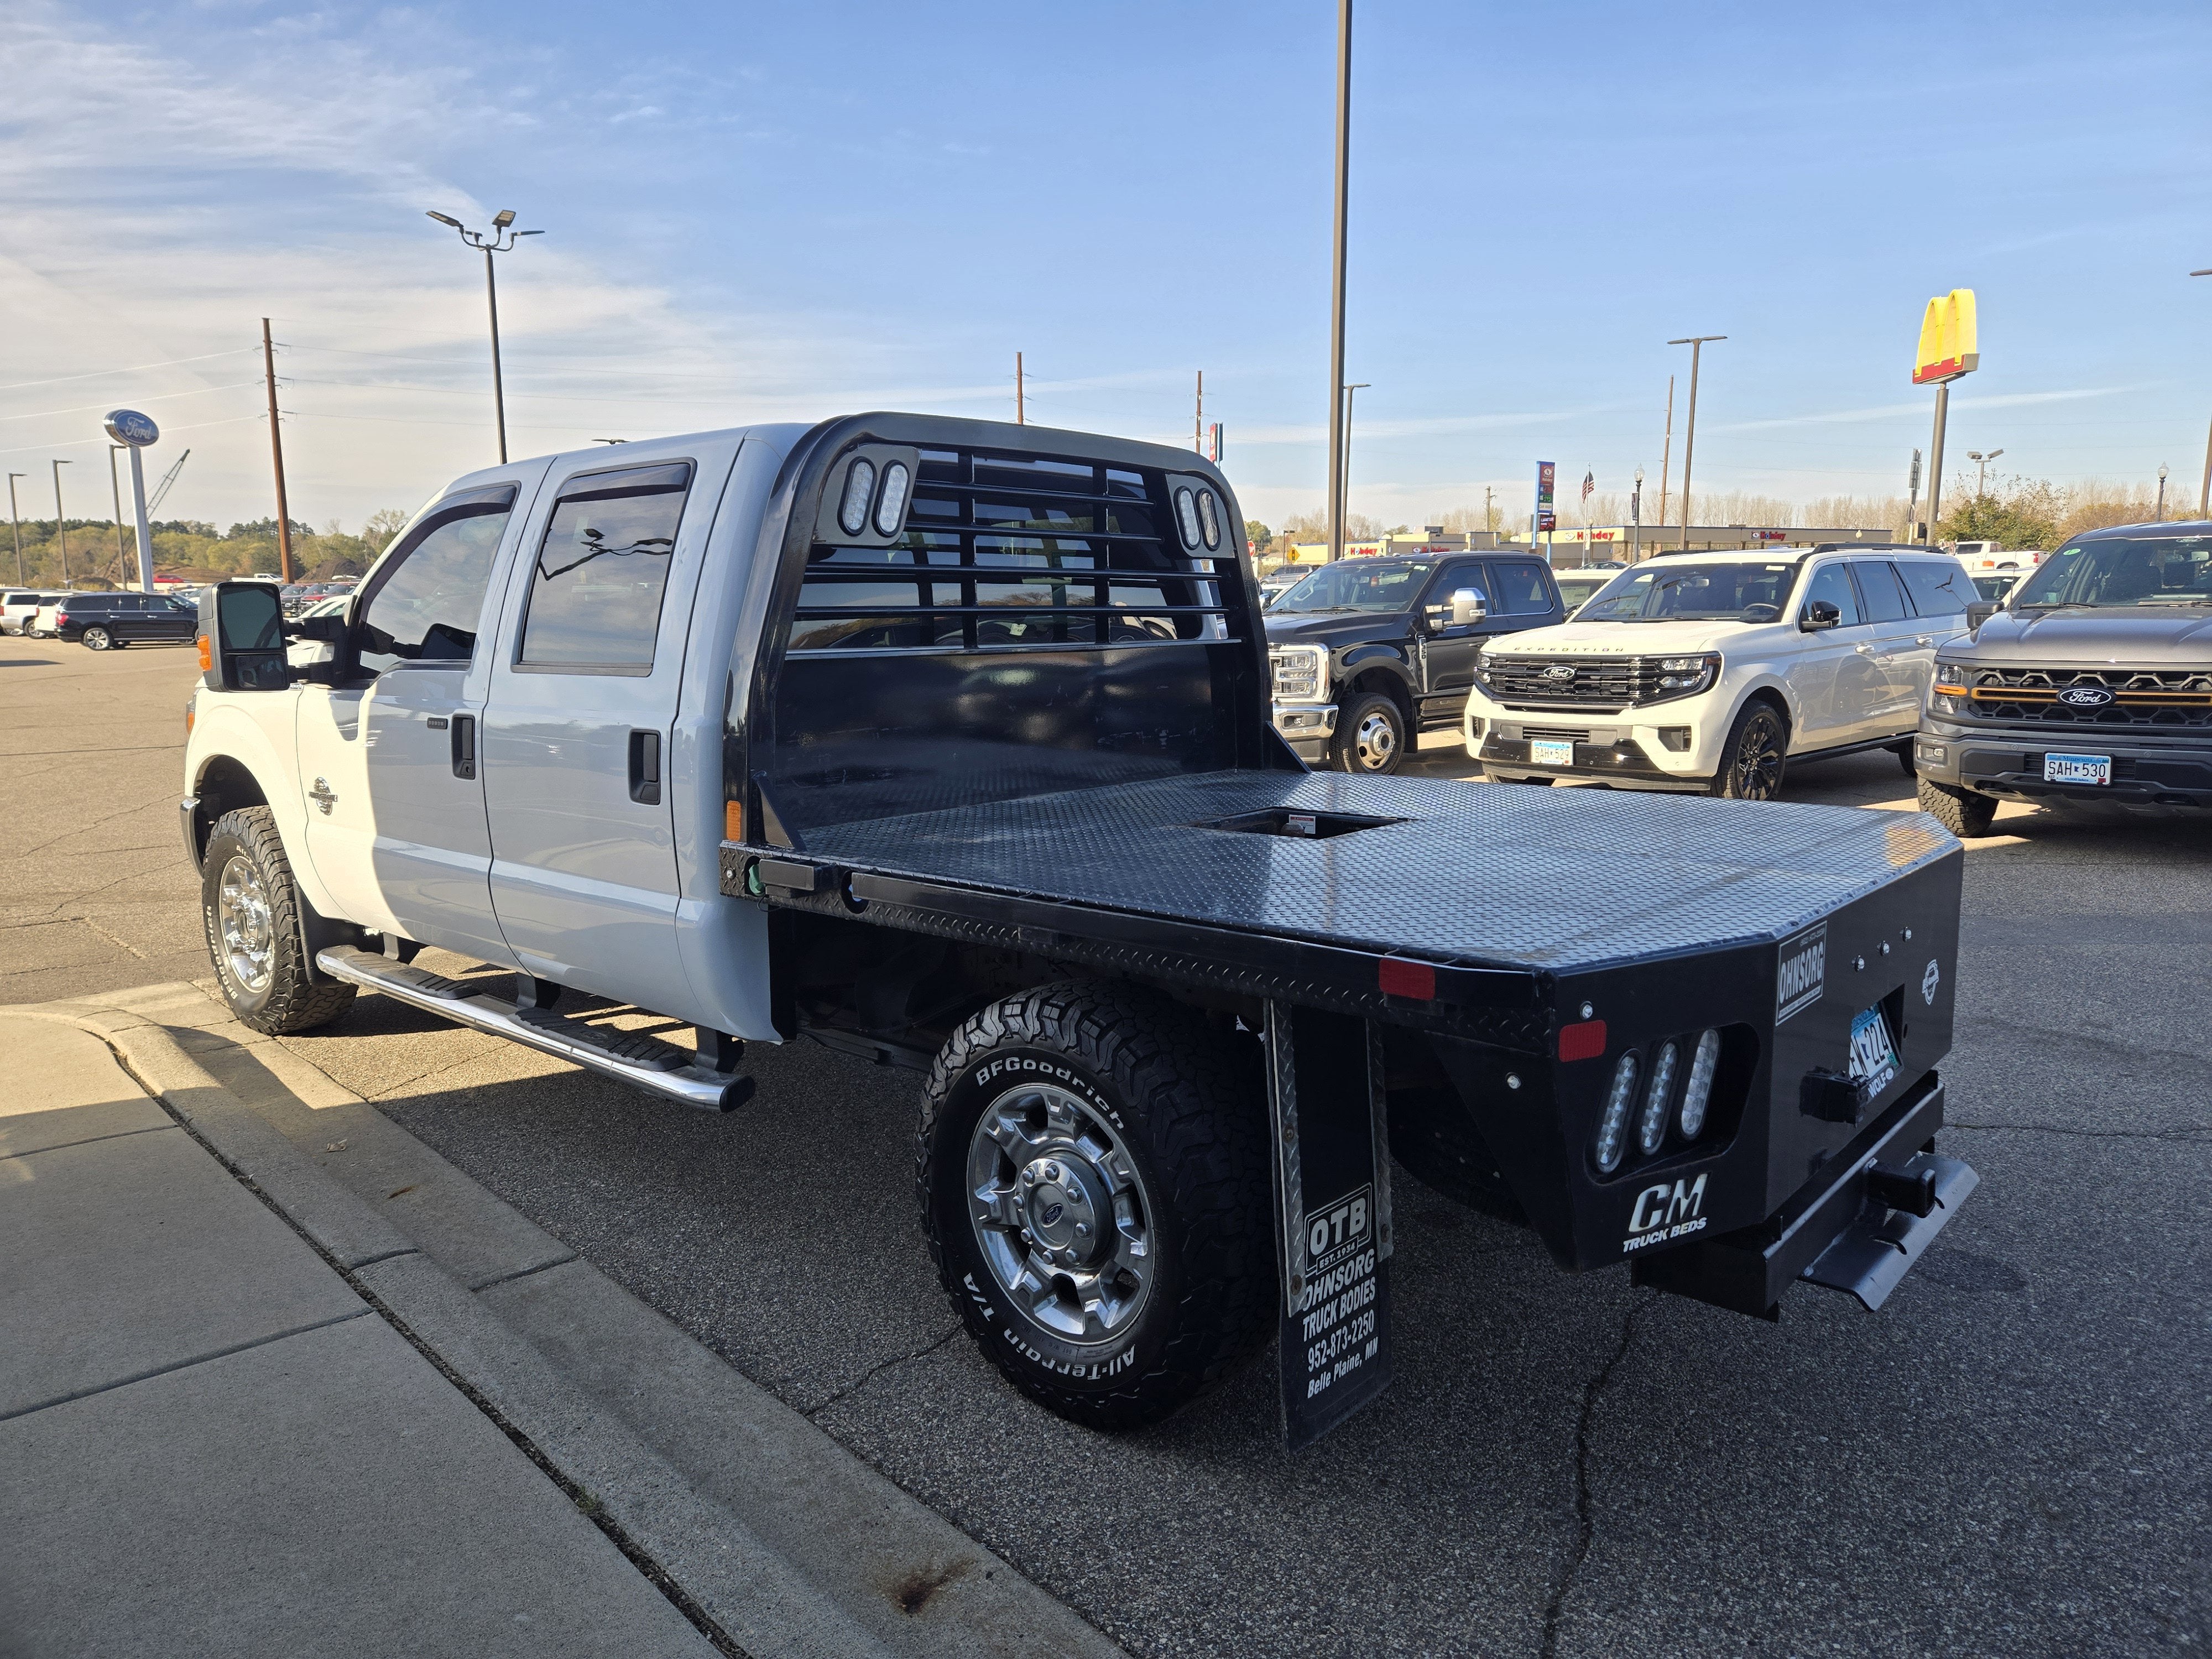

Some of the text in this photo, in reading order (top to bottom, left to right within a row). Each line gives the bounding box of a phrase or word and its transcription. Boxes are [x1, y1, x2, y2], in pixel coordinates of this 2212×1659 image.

[125, 416, 152, 440] Ford
[1549, 668, 1573, 678] Ford
[2069, 691, 2101, 703] Ford
[1535, 747, 1569, 760] SAH 529
[2048, 761, 2106, 778] SAH 530
[1779, 941, 1824, 1004] OHNSORG
[1864, 1018, 1892, 1066] 224
[975, 1057, 1125, 1129] BFGoodrich
[1867, 1072, 1886, 1098] WOLF
[1046, 1207, 1060, 1223] Ford
[1310, 1197, 1366, 1256] OTB
[1629, 1173, 1708, 1233] CM
[1319, 1241, 1355, 1269] EST. 1934
[1623, 1217, 1707, 1253] TRUCK BEDS
[963, 1272, 994, 1322] T/A
[1303, 1276, 1376, 1342] TRUCK BODIES
[1004, 1328, 1136, 1380] All-Terrain
[1308, 1309, 1375, 1373] 952-873-2250
[1307, 1336, 1379, 1399] Belle Plaine, MN
